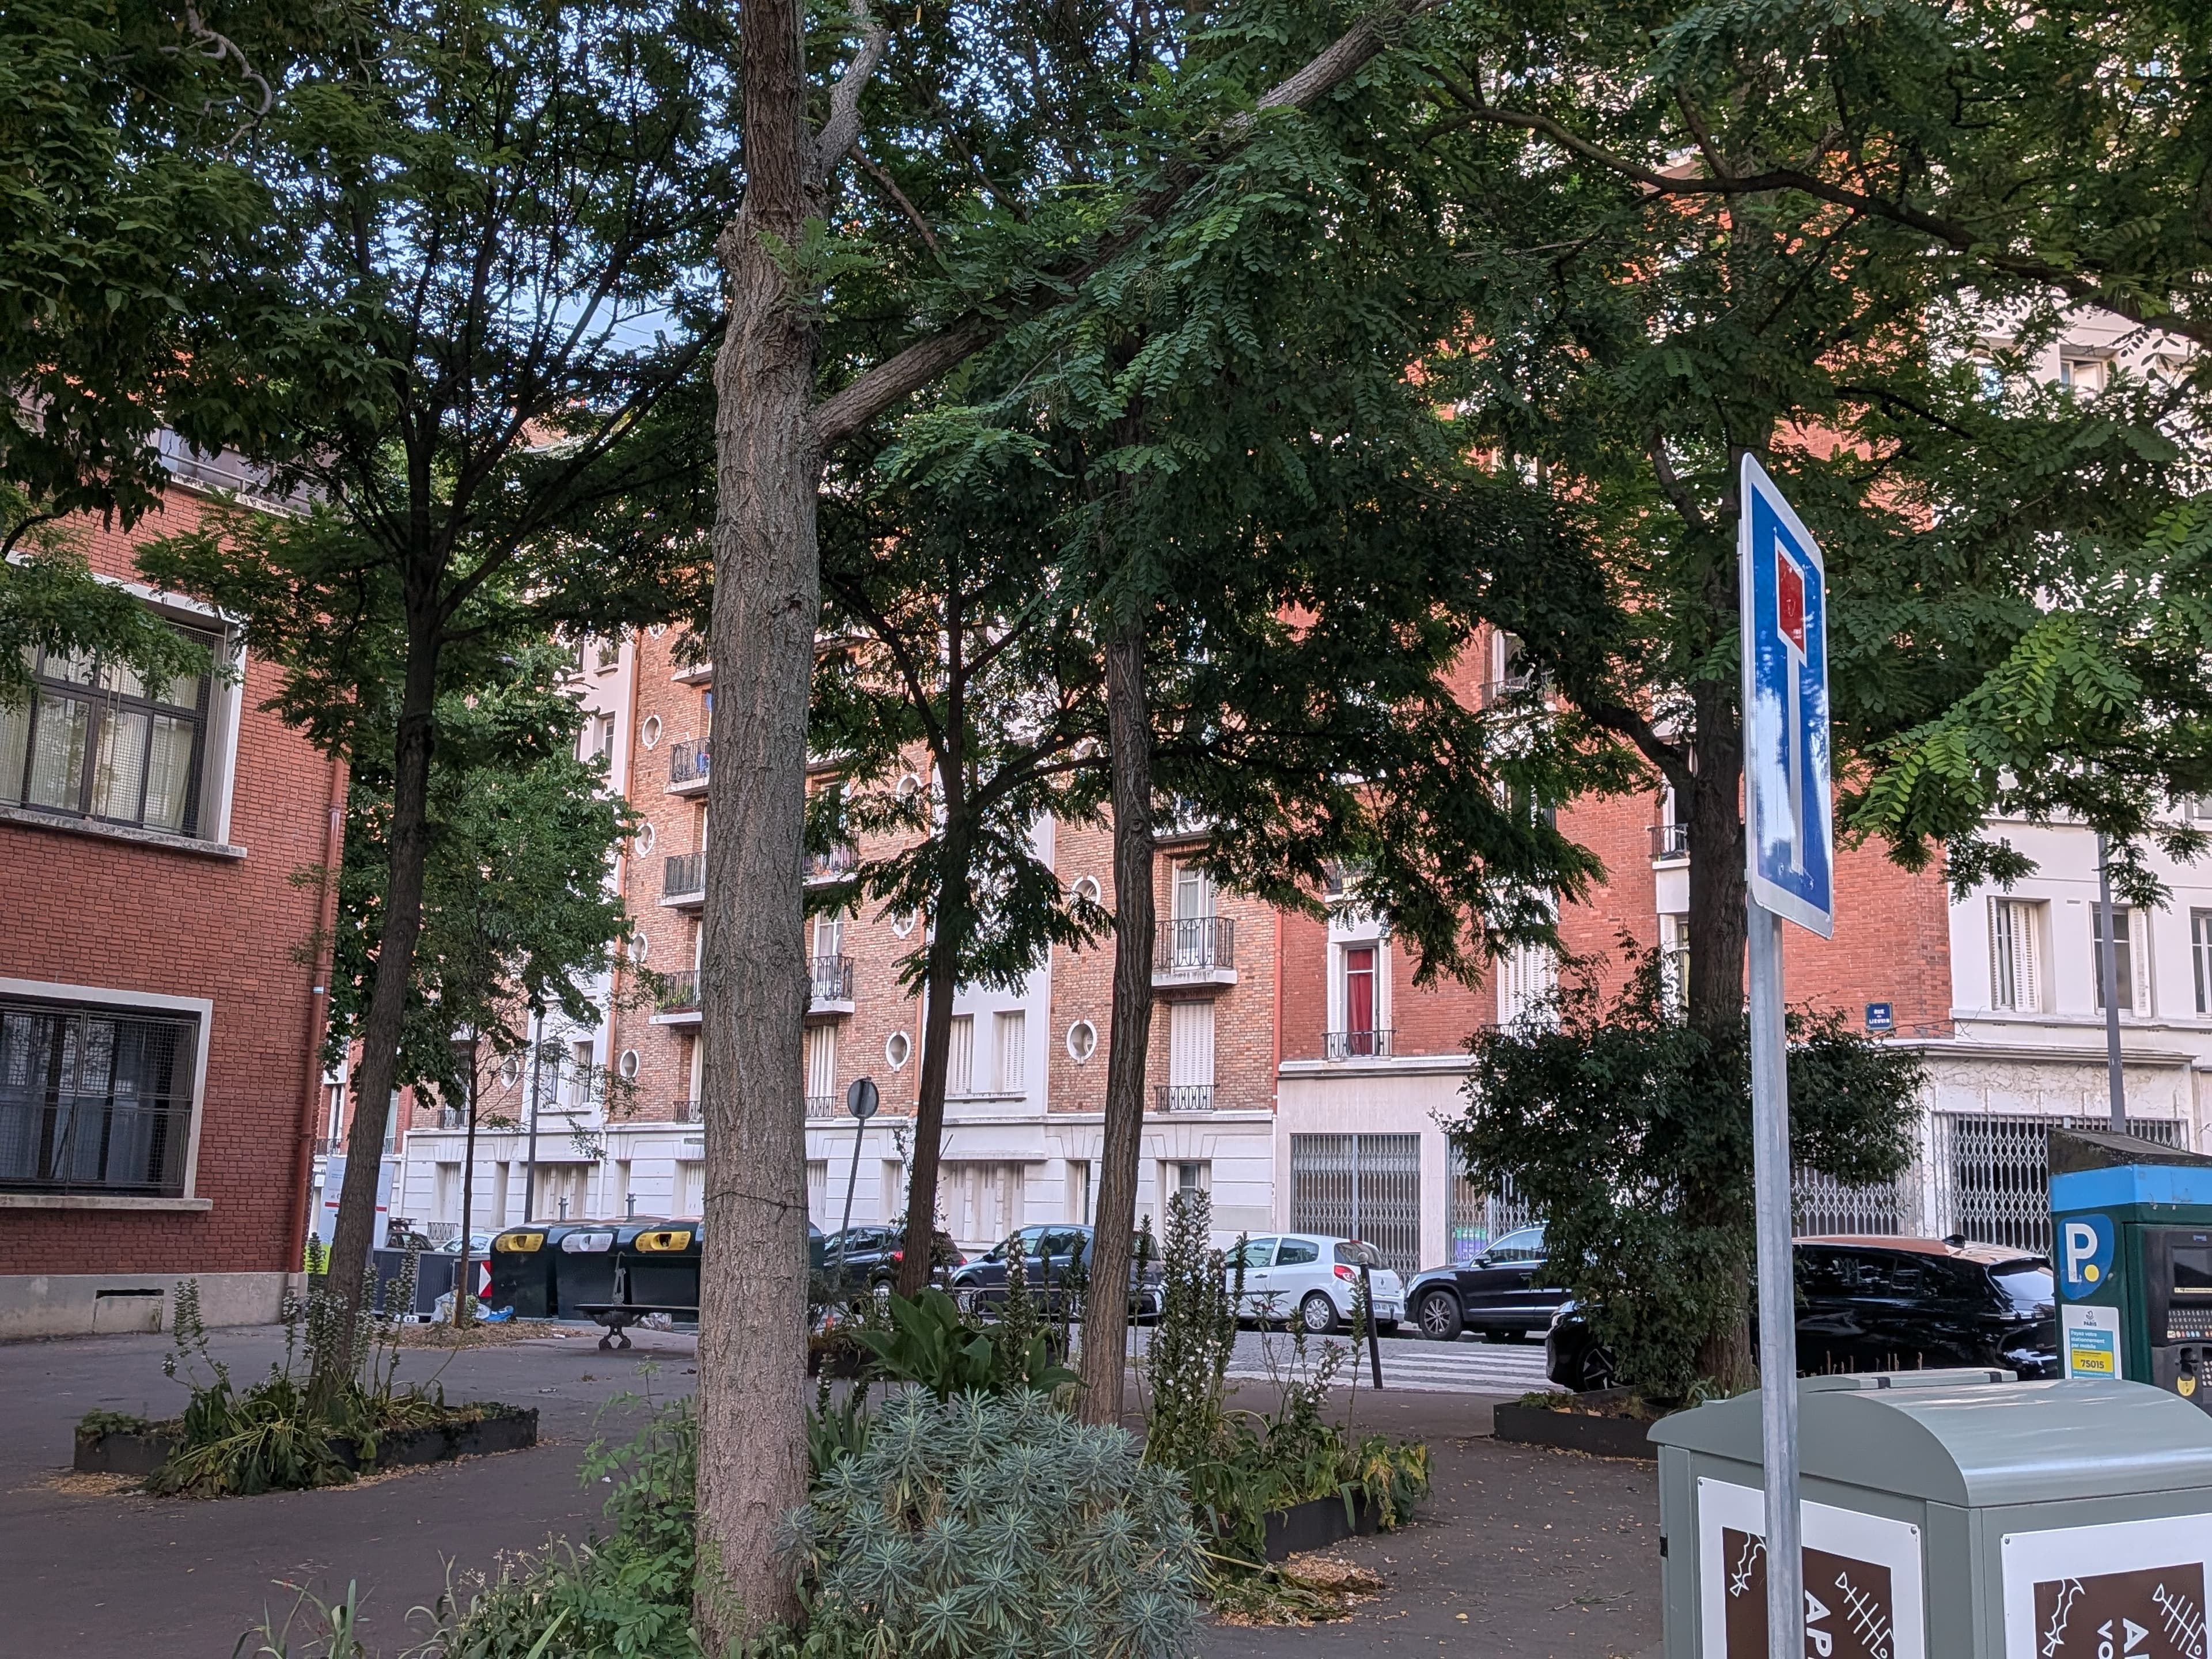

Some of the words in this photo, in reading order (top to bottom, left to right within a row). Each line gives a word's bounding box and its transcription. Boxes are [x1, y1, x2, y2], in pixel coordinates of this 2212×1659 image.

[2065, 1223, 2098, 1283] P
[2080, 1359, 2105, 1369] 75015
[1805, 1589, 1832, 1659] AP
